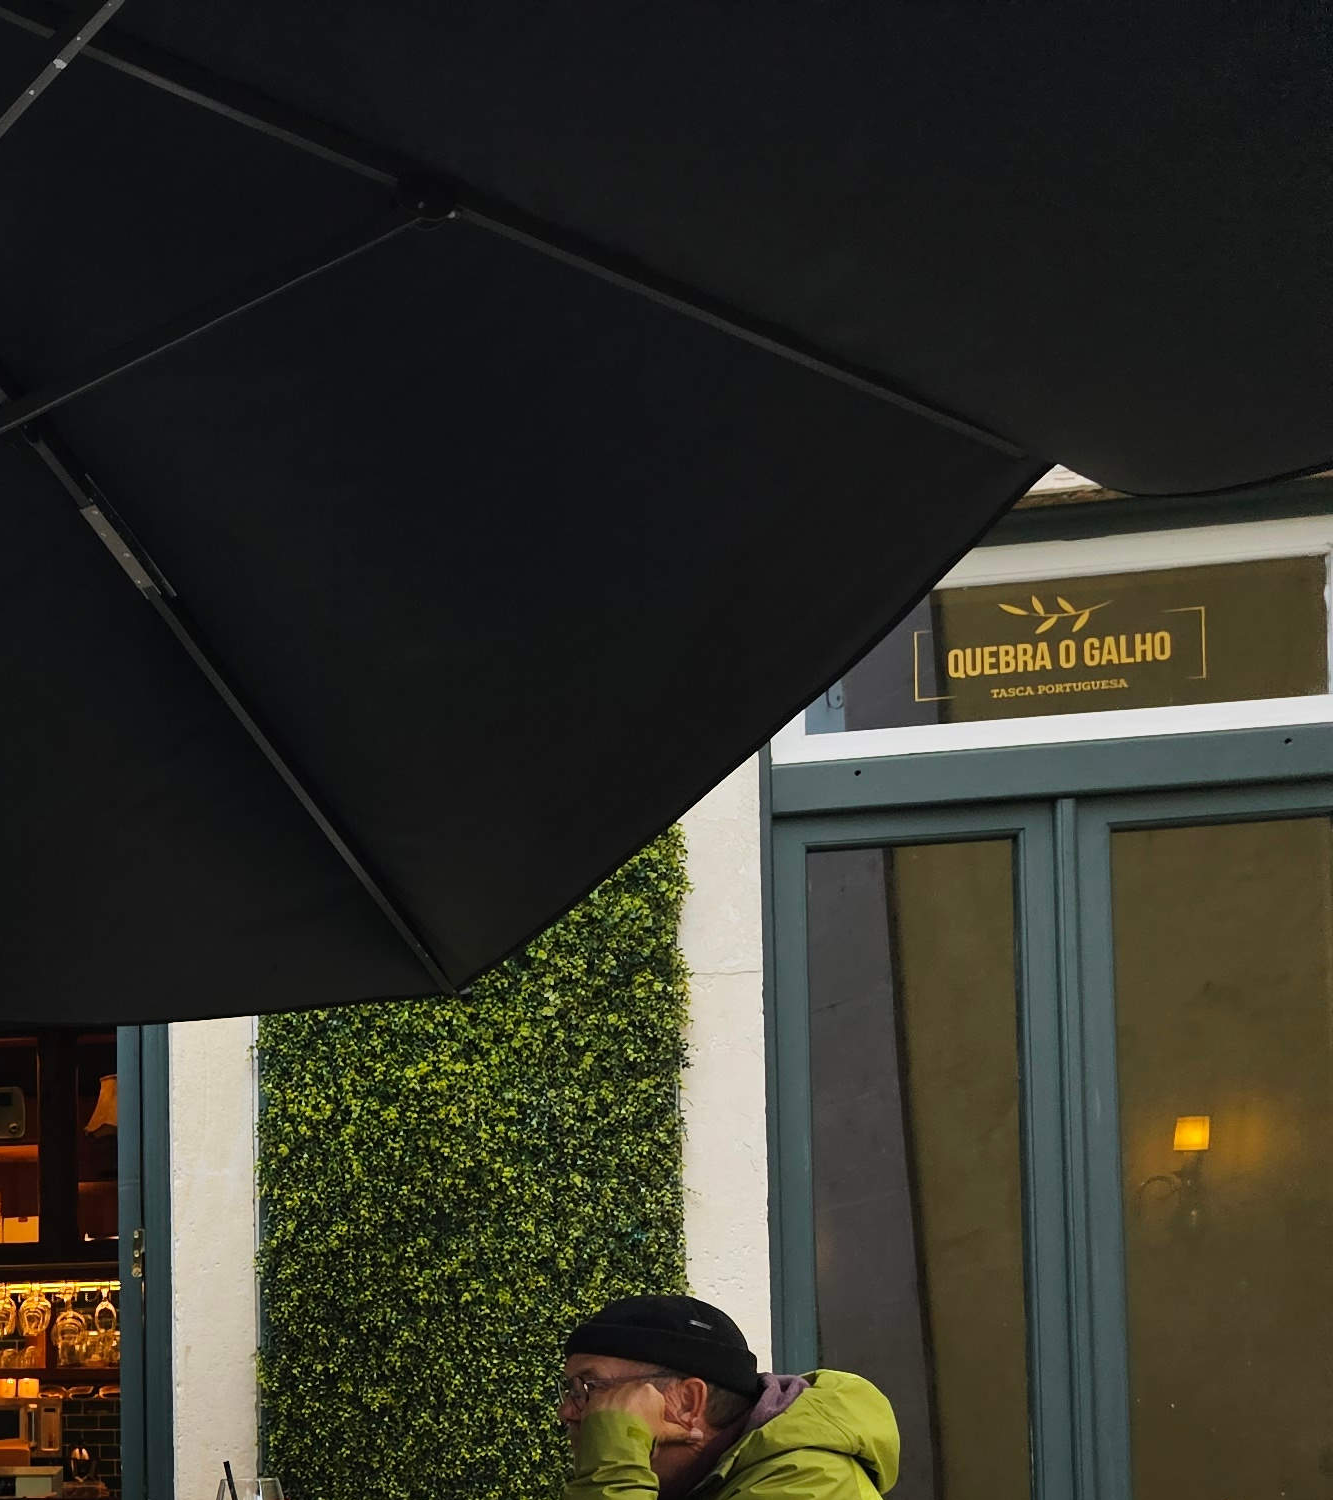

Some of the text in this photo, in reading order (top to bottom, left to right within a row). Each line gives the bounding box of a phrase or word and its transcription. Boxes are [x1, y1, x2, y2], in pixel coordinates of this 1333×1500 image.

[947, 630, 1172, 679] QUEBRA O GALHO
[990, 677, 1129, 699] TASCA PORTUGUESA
